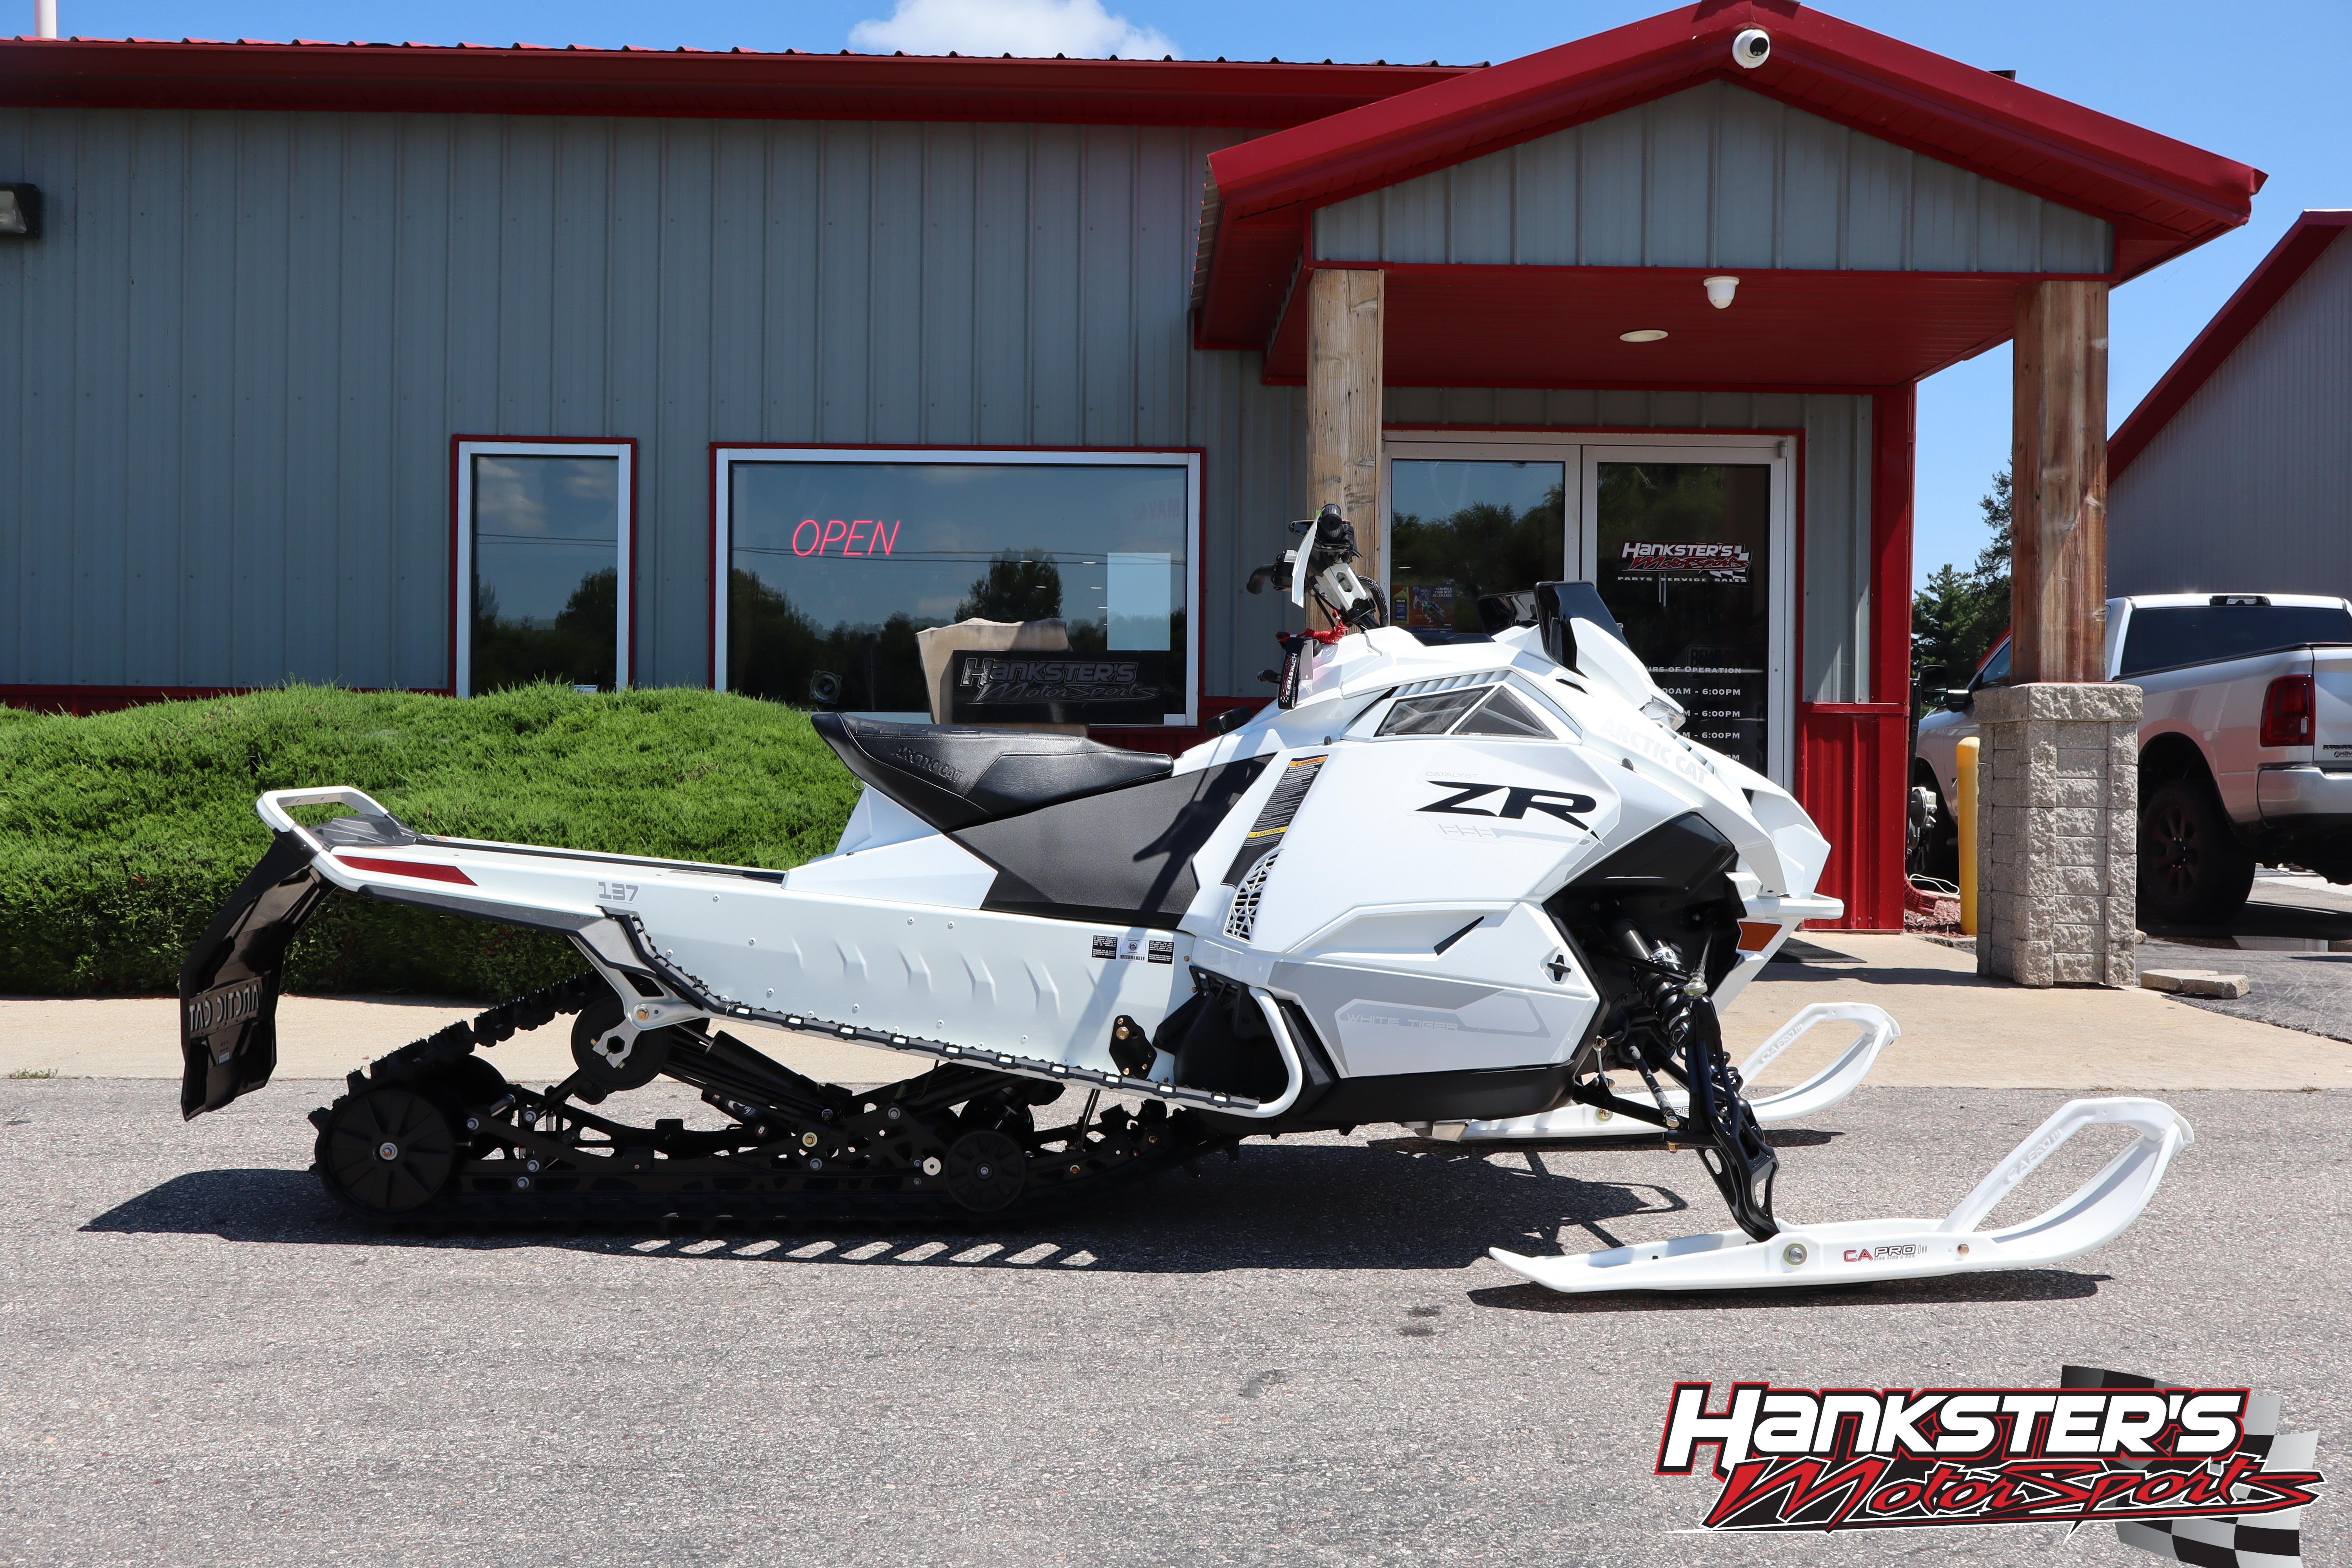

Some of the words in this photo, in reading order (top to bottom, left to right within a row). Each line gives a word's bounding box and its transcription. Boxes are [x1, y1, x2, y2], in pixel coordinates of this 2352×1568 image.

[793, 519, 900, 557] OPEN
[1600, 718, 1671, 764] ARCTIC
[1675, 755, 1708, 784] CAT
[1414, 780, 1605, 847] ZR
[598, 881, 639, 902] 137
[1346, 1013, 1399, 1025] WHITE
[1408, 1019, 1458, 1031] TIGER
[1777, 1030, 1794, 1048] PRO
[2028, 1138, 2051, 1162] PRO
[1874, 1244, 1916, 1257] PRO
